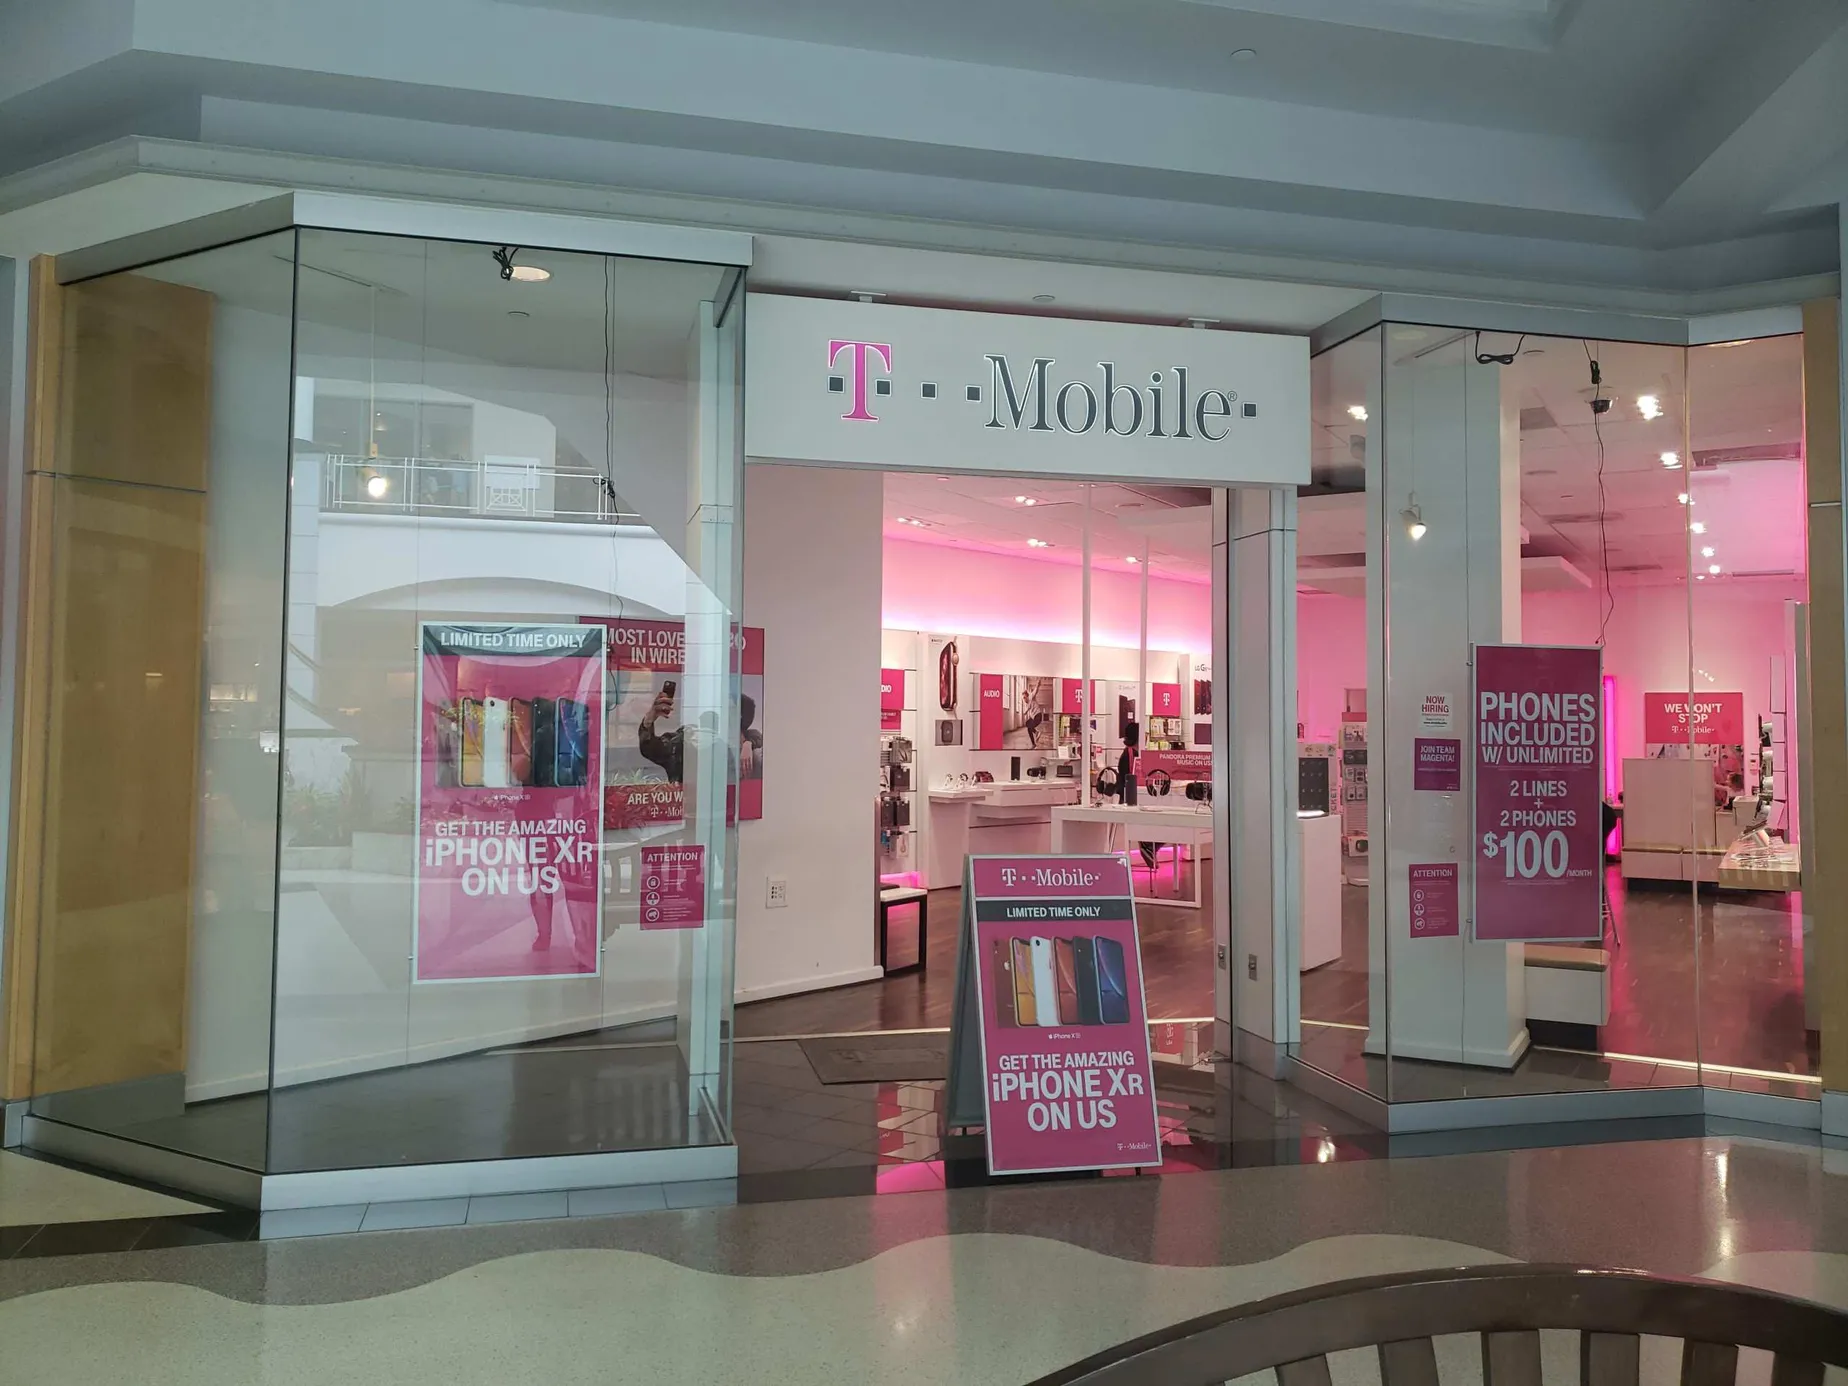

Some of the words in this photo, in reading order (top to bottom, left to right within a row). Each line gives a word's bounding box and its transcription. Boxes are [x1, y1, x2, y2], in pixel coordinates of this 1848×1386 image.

[440, 632, 503, 647] LIMITED
[506, 633, 544, 647] TIME
[546, 633, 586, 648] ONLY
[608, 628, 645, 645] MOST
[648, 630, 686, 648] LOVE
[631, 646, 646, 664] IN
[649, 648, 686, 665] WIRE
[880, 684, 892, 693] DIO
[983, 690, 1000, 698] AUDIO
[1163, 692, 1170, 706] T
[1425, 695, 1445, 704] NOW
[1480, 691, 1596, 722] PHONES
[1421, 704, 1449, 713] HIRING
[1664, 703, 1682, 713] WE
[1480, 721, 1595, 746] INCLUDED
[1420, 745, 1435, 753] JOIN
[1436, 745, 1455, 754] TEAM
[1420, 754, 1455, 762] MAGENTA!
[1482, 746, 1503, 765] W/
[1506, 746, 1594, 764] UNLIMITED
[1509, 780, 1519, 797] 2
[1522, 780, 1568, 797] LINES
[627, 793, 649, 805] ARE
[650, 791, 672, 803] YOU
[1500, 809, 1510, 827] 2
[1512, 809, 1577, 827] PHONES
[435, 821, 470, 837] GET
[472, 820, 505, 836] THE
[508, 819, 587, 835] AMAZING
[425, 836, 548, 866] iPHONE
[647, 852, 698, 862] ATTENTION
[1483, 830, 1569, 878] $100
[461, 867, 509, 896] ON
[517, 865, 560, 895] US
[1035, 868, 1093, 886] Mobile
[1413, 869, 1453, 877] ATTENTION
[1006, 907, 1047, 918] LIMITED
[1048, 906, 1073, 917] TIME
[1074, 906, 1101, 917] ONLY
[999, 1054, 1029, 1071] GET
[1031, 1053, 1062, 1069] THE
[1064, 1050, 1134, 1068] AMAZING
[992, 1069, 1103, 1102] iPHONE
[1027, 1101, 1071, 1132] ON
[1076, 1099, 1117, 1129] US
